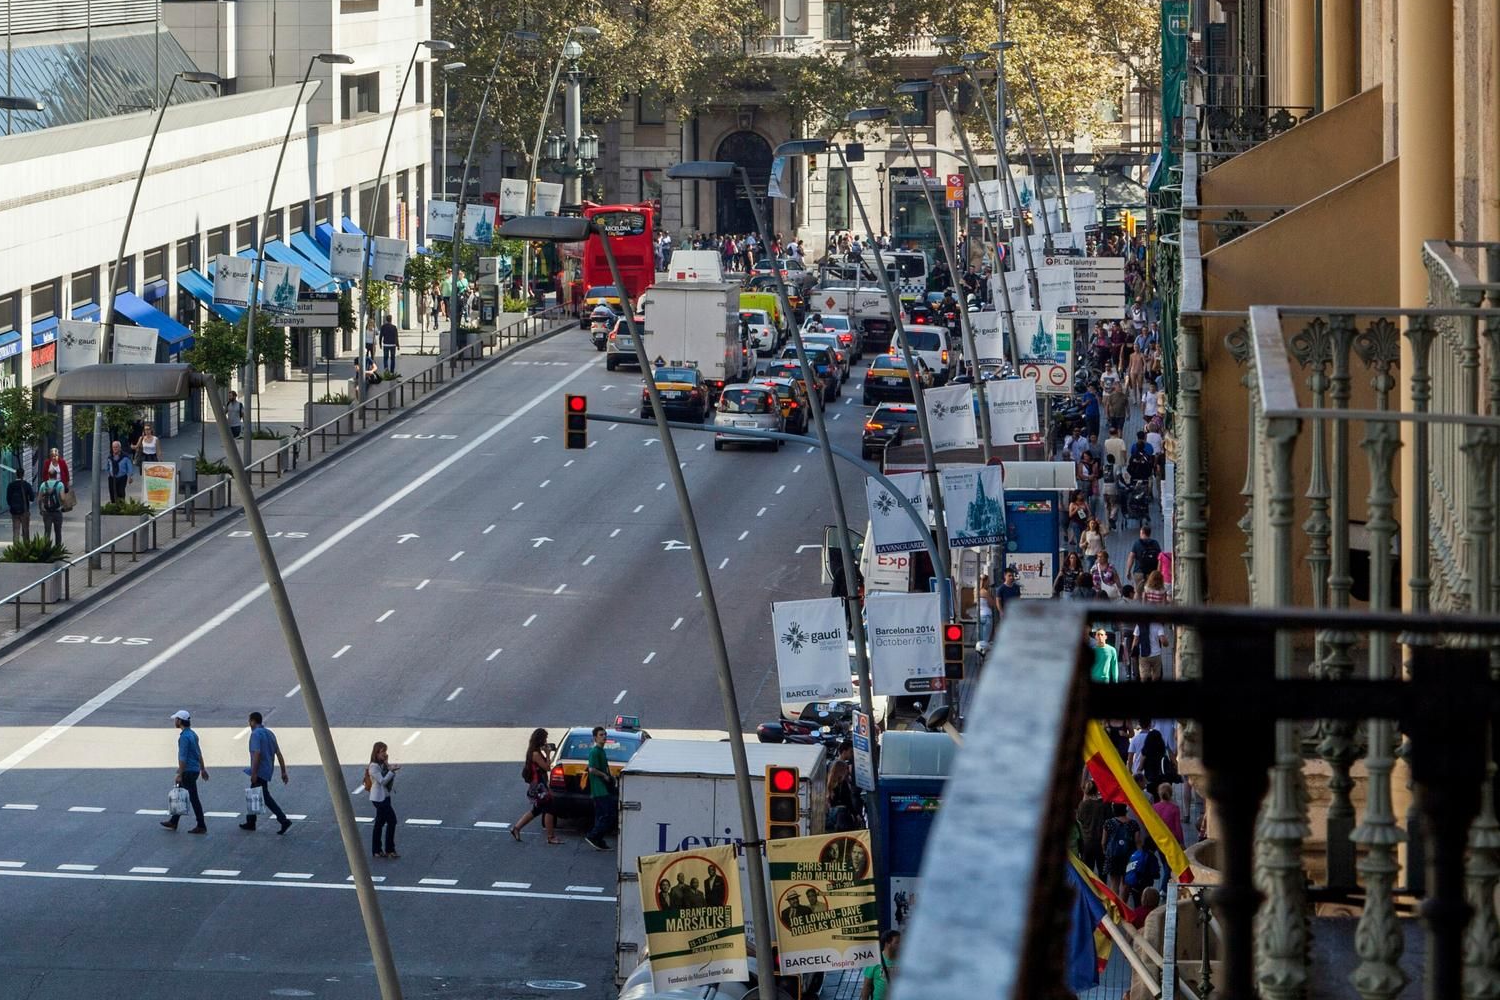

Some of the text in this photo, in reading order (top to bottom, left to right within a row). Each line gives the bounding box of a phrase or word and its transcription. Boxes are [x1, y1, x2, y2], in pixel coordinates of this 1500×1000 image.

[811, 628, 841, 644] gaudi
[875, 625, 935, 636] Barcelona 2014
[56, 635, 154, 645] BUS
[797, 862, 822, 872] CHRIS
[825, 862, 847, 871] THILE
[791, 871, 853, 881] BRAD MEHLDAU
[680, 906, 724, 919] BRANFORD
[666, 915, 725, 932] MARSALIS
[789, 915, 804, 928] JOE
[791, 914, 864, 936] DOUGLAS QUINTET
